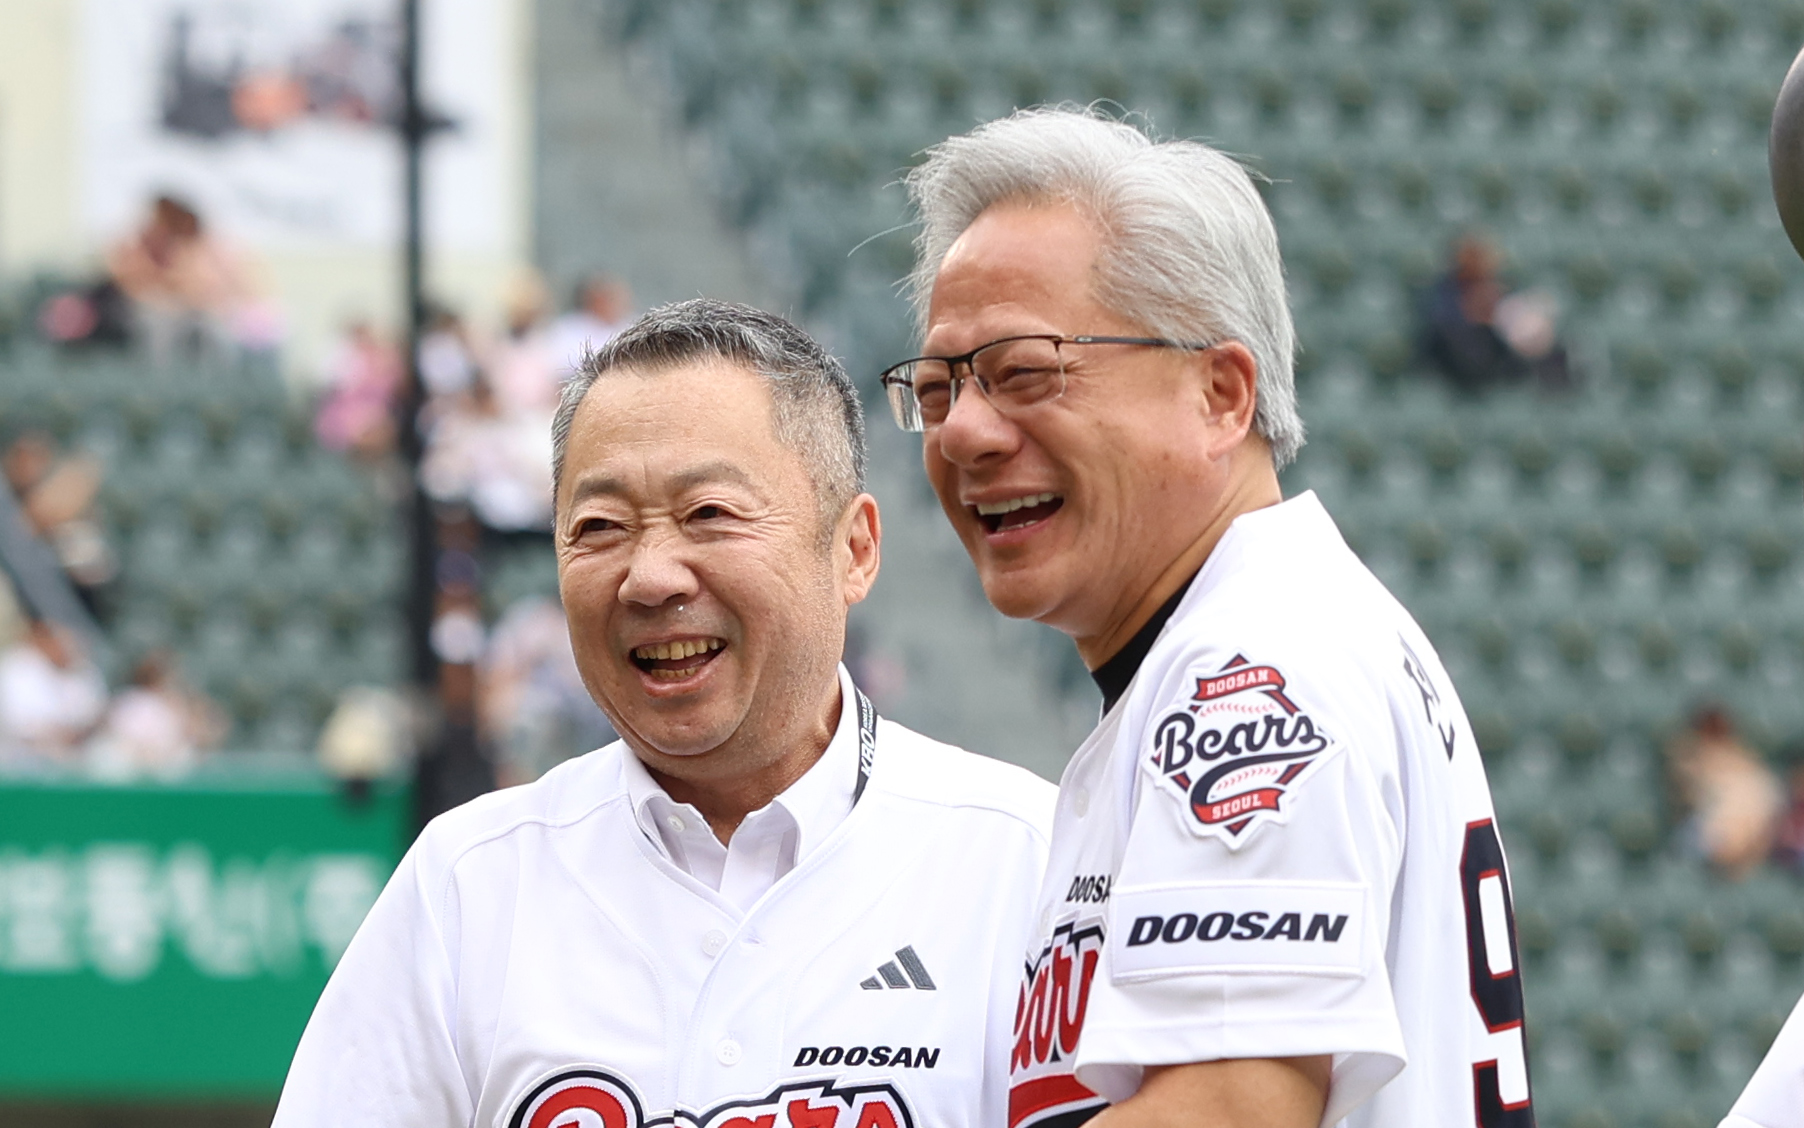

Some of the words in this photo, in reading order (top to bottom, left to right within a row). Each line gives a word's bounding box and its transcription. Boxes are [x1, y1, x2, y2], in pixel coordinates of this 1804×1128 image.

[1206, 669, 1269, 696] DOOSAN
[1154, 712, 1328, 788] Bears
[1212, 794, 1262, 820] SEOUL
[1127, 911, 1349, 947] DOOSAN
[793, 1046, 941, 1068] DOOSAN
